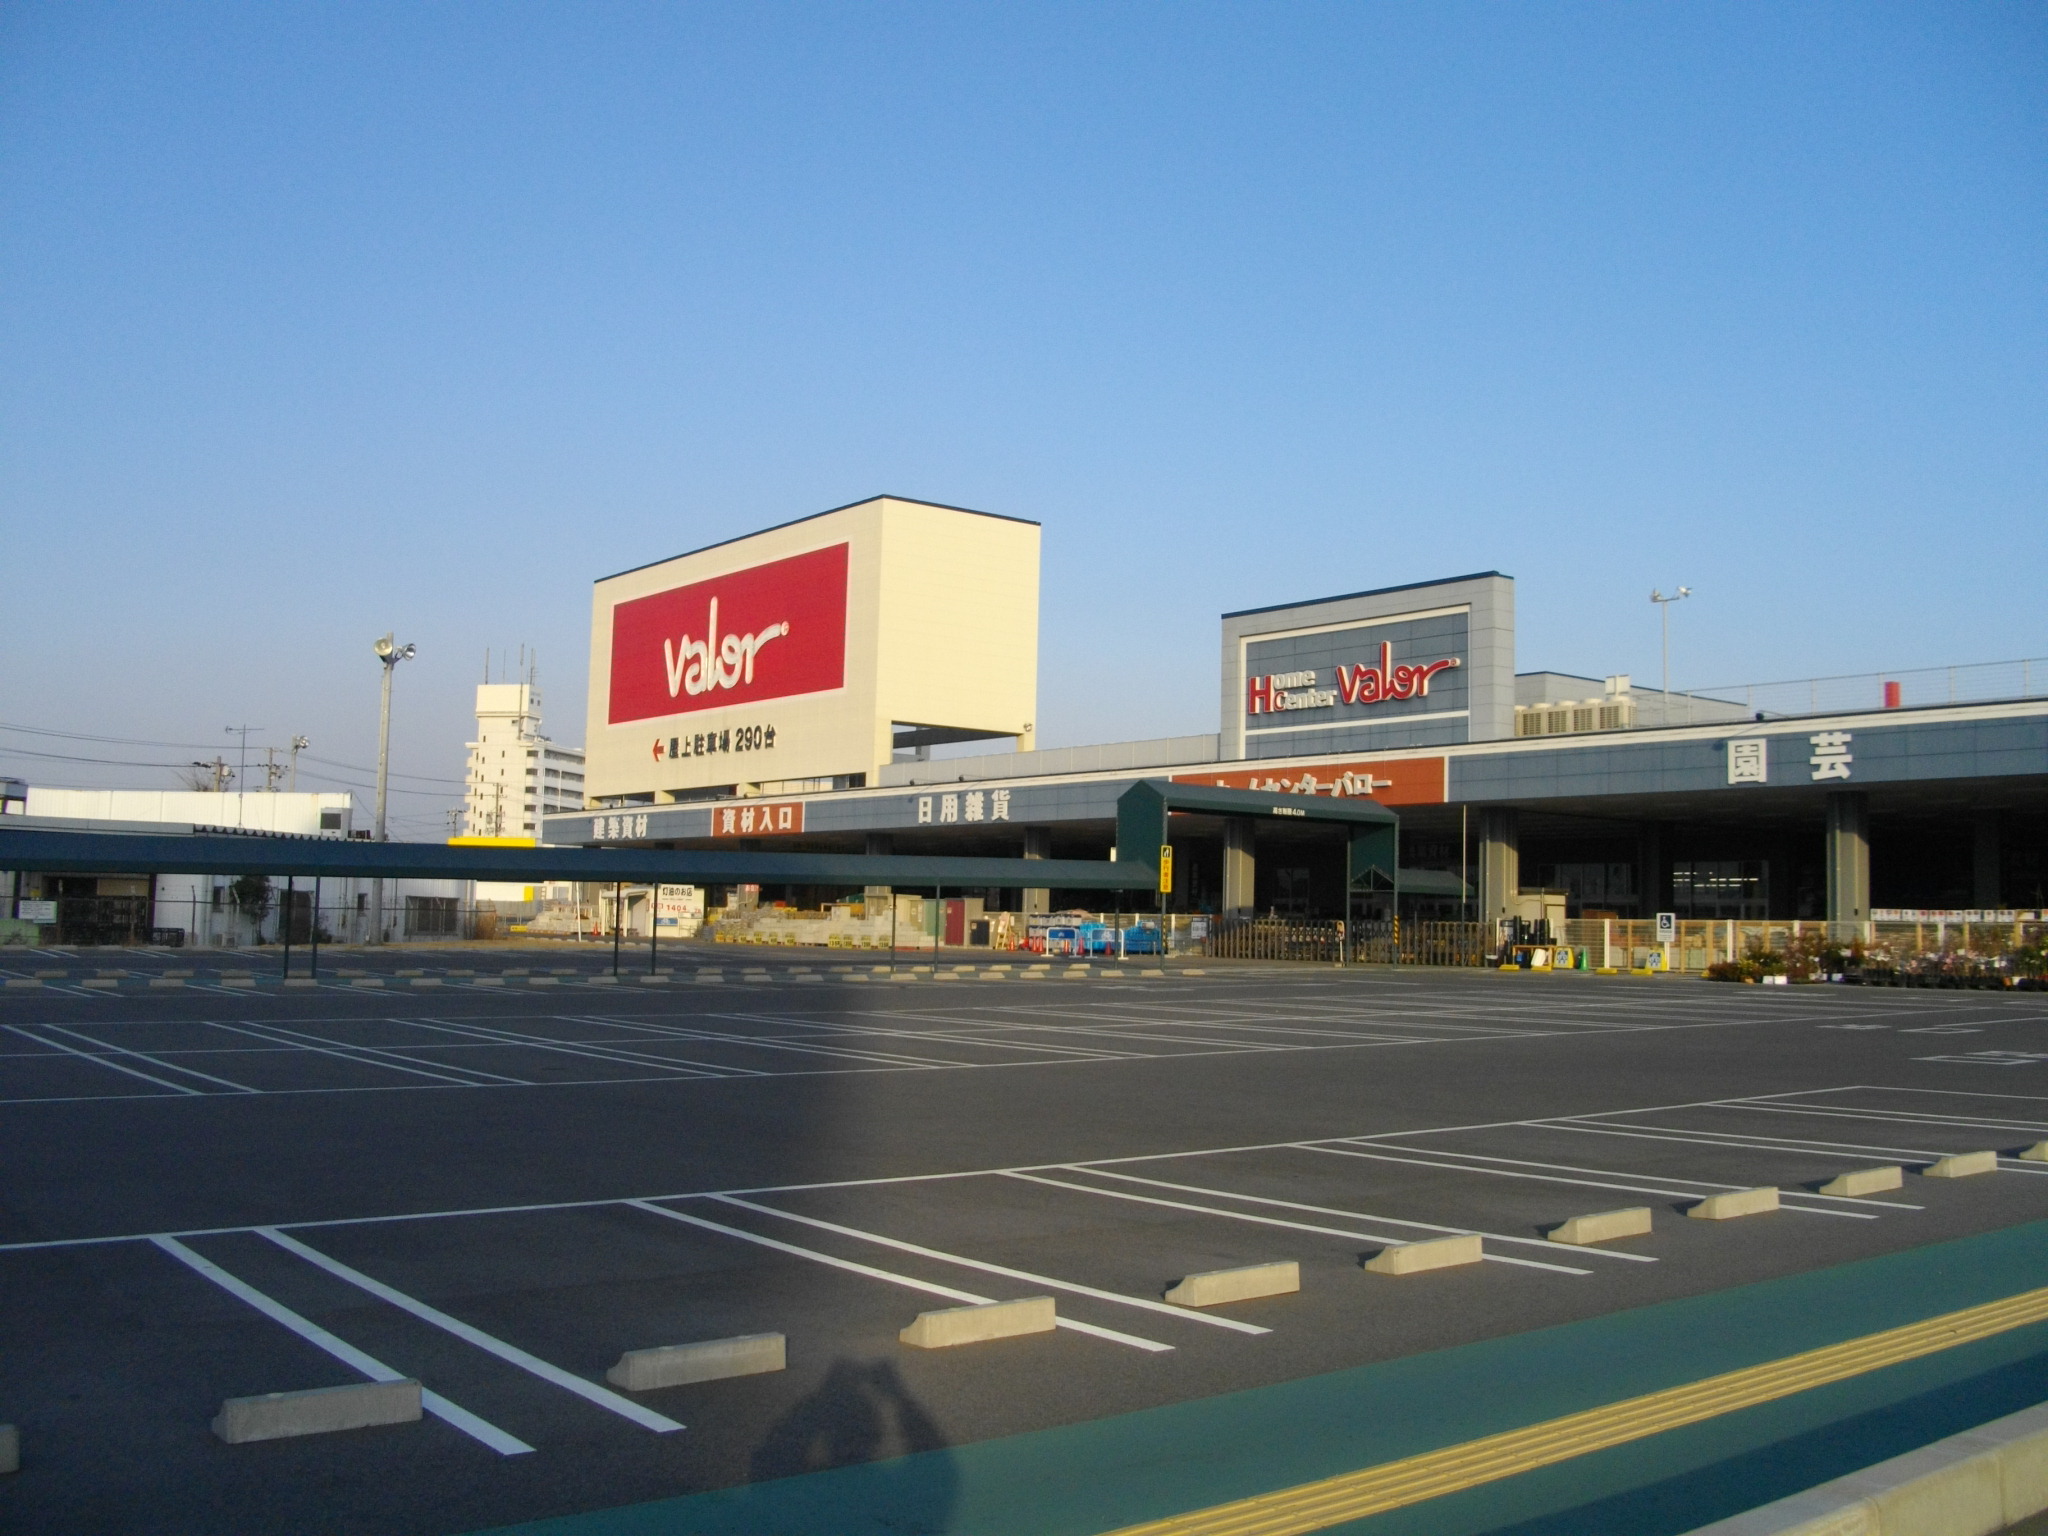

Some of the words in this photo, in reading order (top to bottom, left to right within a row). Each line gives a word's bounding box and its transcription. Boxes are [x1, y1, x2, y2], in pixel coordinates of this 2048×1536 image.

[735, 723, 776, 752] 290台
[1728, 732, 1853, 784] 園芸
[722, 806, 792, 834] 資材入口
[918, 789, 1011, 823] 日用雑貨
[593, 814, 648, 840] 建築資材
